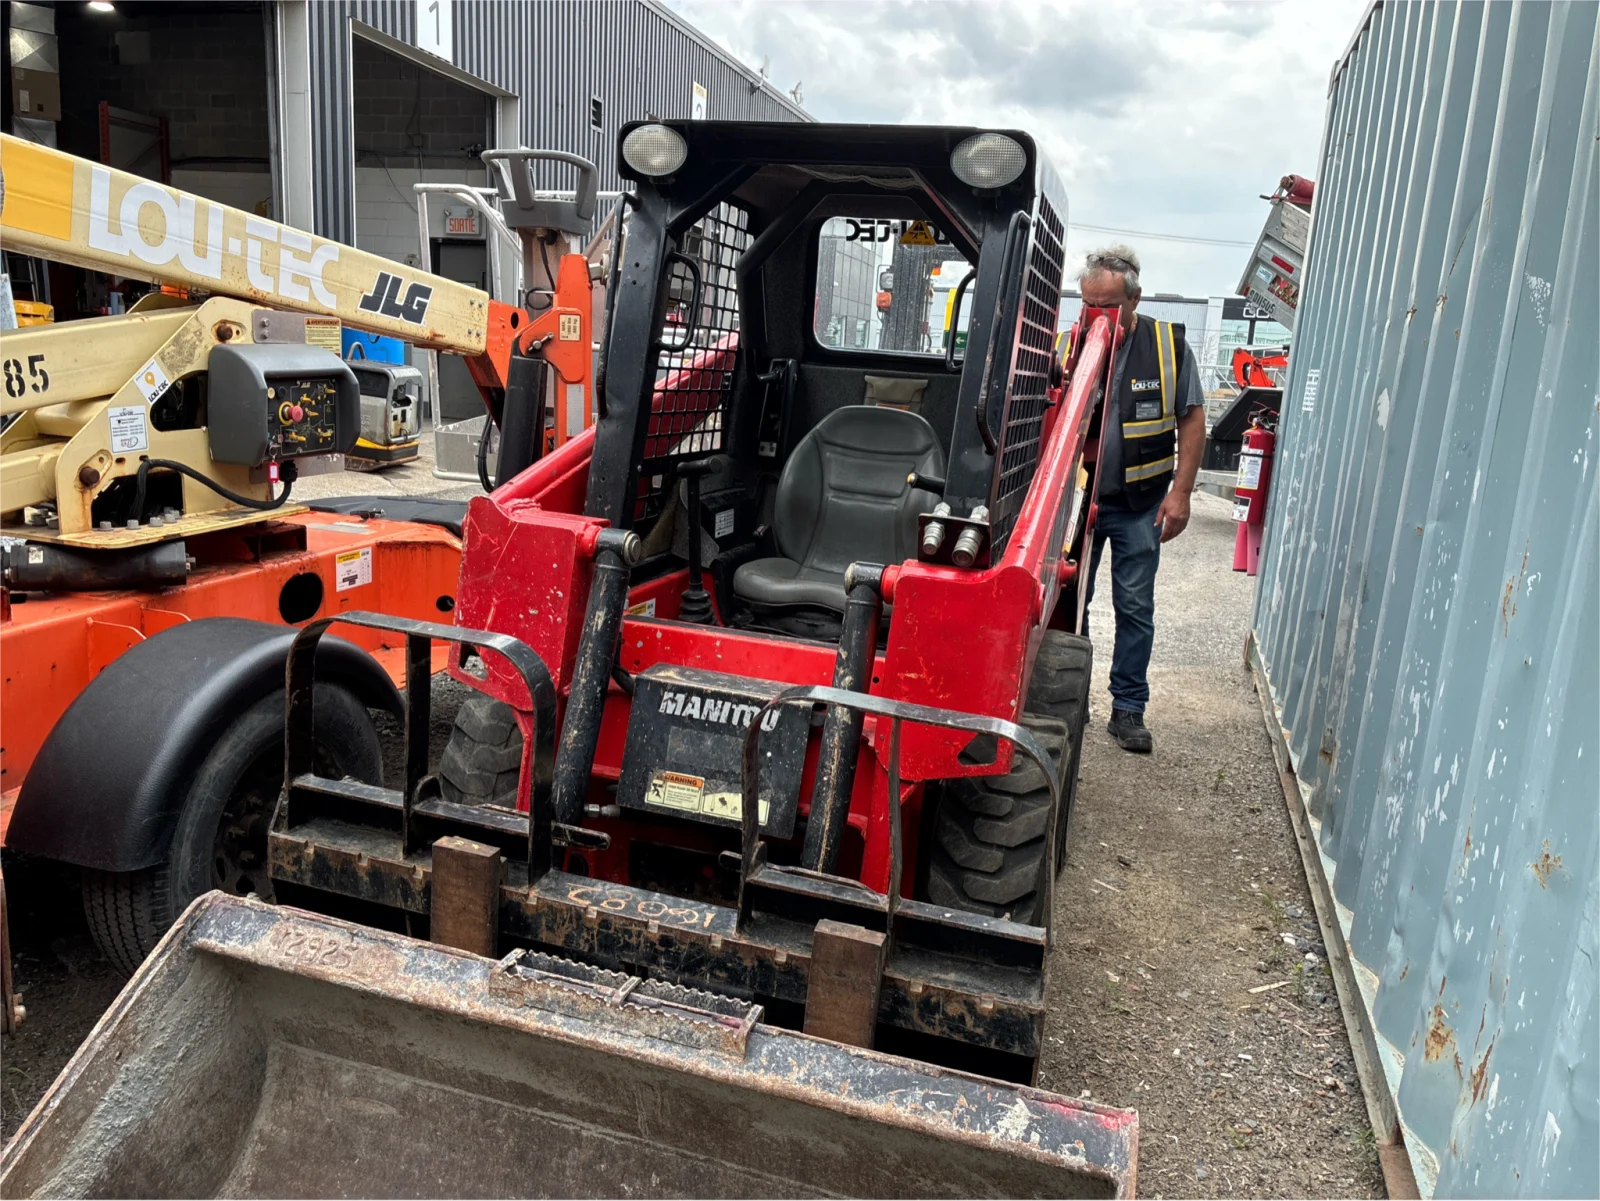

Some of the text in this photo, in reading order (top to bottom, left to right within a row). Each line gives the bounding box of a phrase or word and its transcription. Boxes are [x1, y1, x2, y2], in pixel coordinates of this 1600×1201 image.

[428, 1, 440, 46] 1
[88, 165, 340, 310] LOU-TEC
[448, 217, 475, 233] SORTIE
[358, 271, 433, 325] JLG
[3, 354, 49, 398] 85
[147, 379, 169, 403] LOU-TEC
[1131, 381, 1160, 390] LOU-TEC
[659, 690, 781, 732] MANITOU
